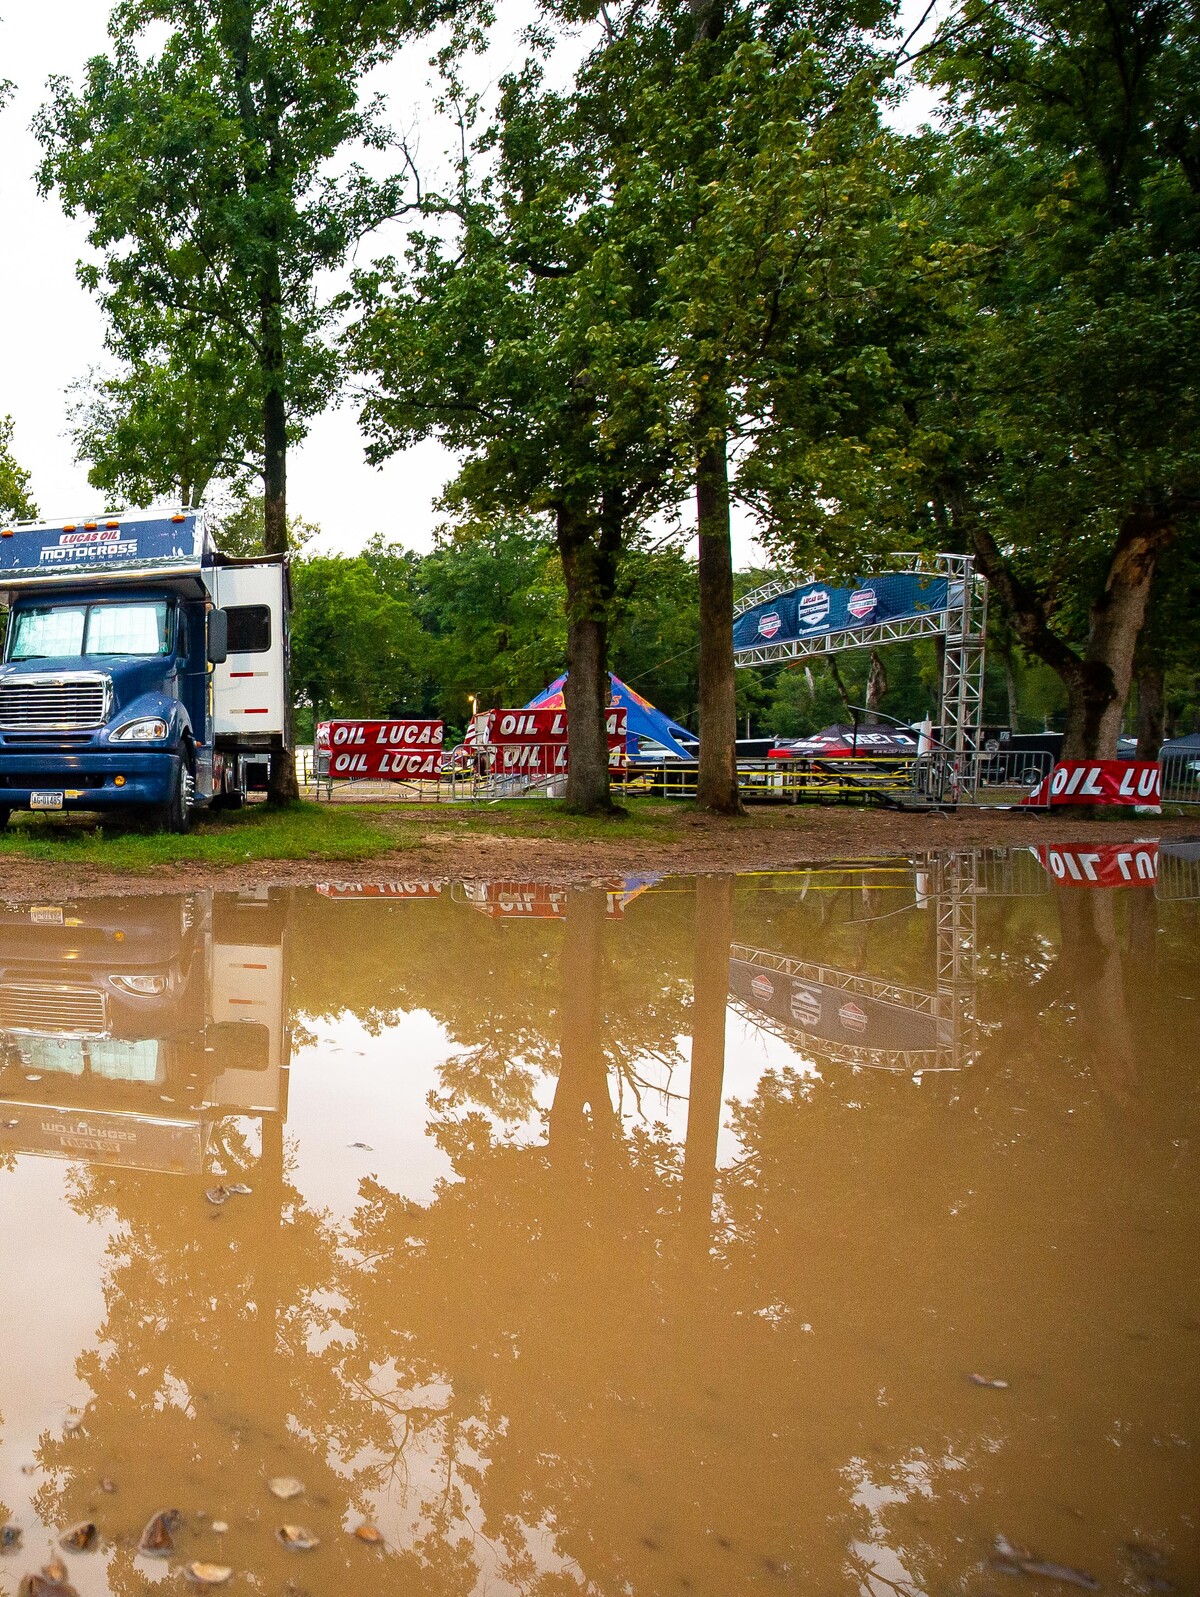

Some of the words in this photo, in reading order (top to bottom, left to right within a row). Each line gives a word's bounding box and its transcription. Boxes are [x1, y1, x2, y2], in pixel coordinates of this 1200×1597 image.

[62, 532, 98, 544] LUCAS
[100, 531, 118, 541] OIL
[40, 543, 138, 560] MOTOCROSS
[333, 726, 366, 745] OIL
[376, 725, 443, 744] LUCAS
[500, 714, 538, 735] OIL
[335, 753, 368, 771] OIL
[378, 754, 442, 774] LUCAS
[503, 746, 542, 767] OIL
[1051, 768, 1103, 795] OIL
